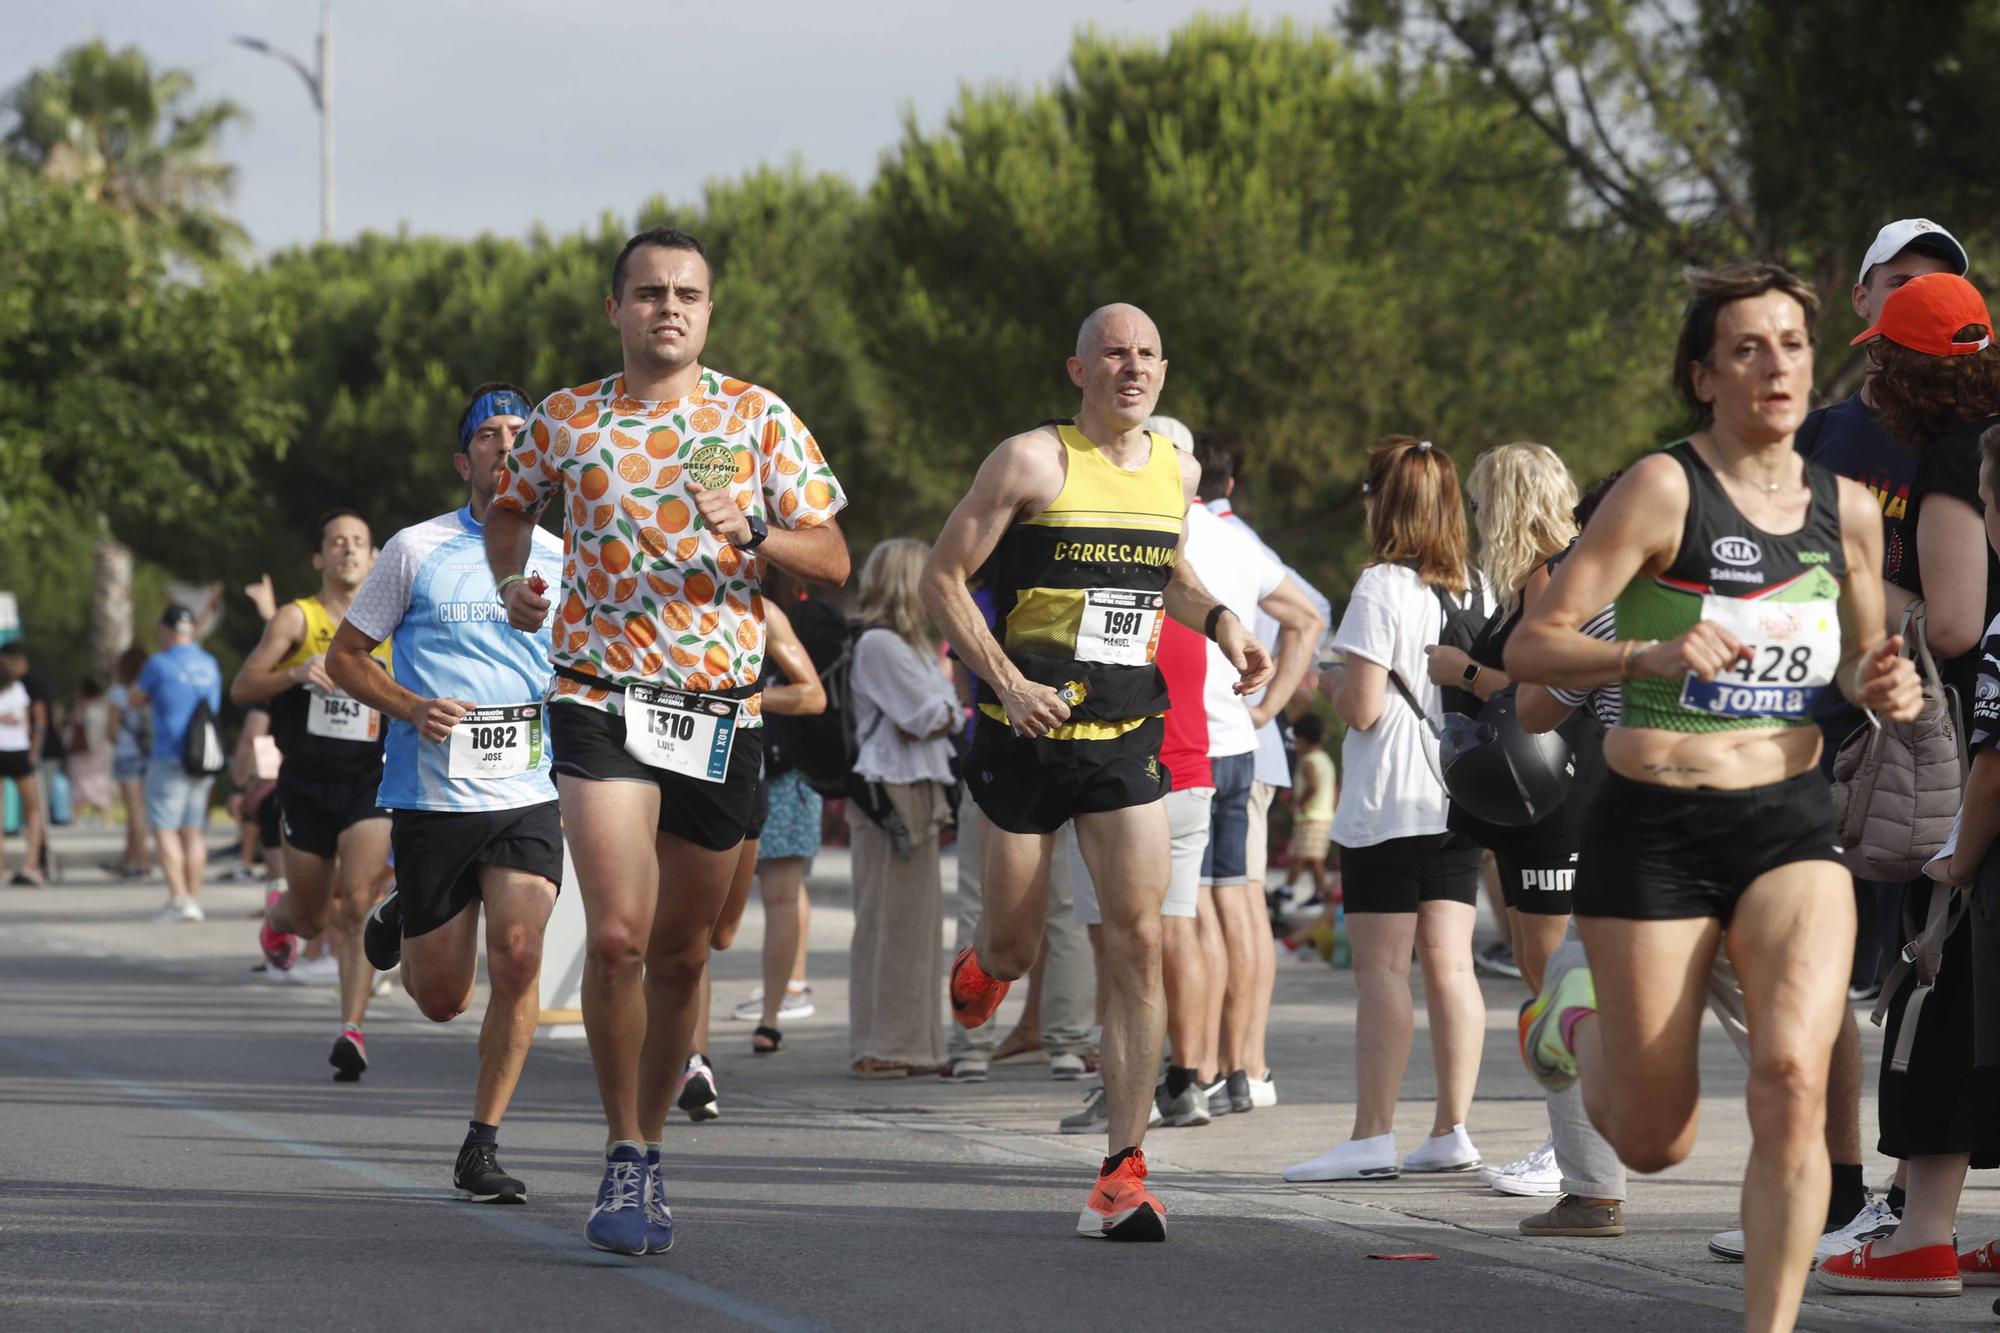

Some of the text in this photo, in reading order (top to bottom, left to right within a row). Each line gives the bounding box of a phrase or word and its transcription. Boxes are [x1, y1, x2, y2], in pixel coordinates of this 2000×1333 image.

[682, 462, 741, 473] GREEN POWER
[1720, 542, 1754, 561] KIA
[440, 602, 469, 623] CLUB
[1104, 610, 1143, 636] 1981
[1104, 637, 1130, 648] MANUEL
[324, 699, 360, 718] 1843
[657, 698, 685, 708] PATERNA
[646, 708, 695, 742] 1310
[471, 725, 517, 750] 1082
[657, 739, 675, 753] LUIS
[716, 728, 729, 746] BOX
[482, 752, 503, 761] JOSE
[1521, 869, 1577, 891] PUM
